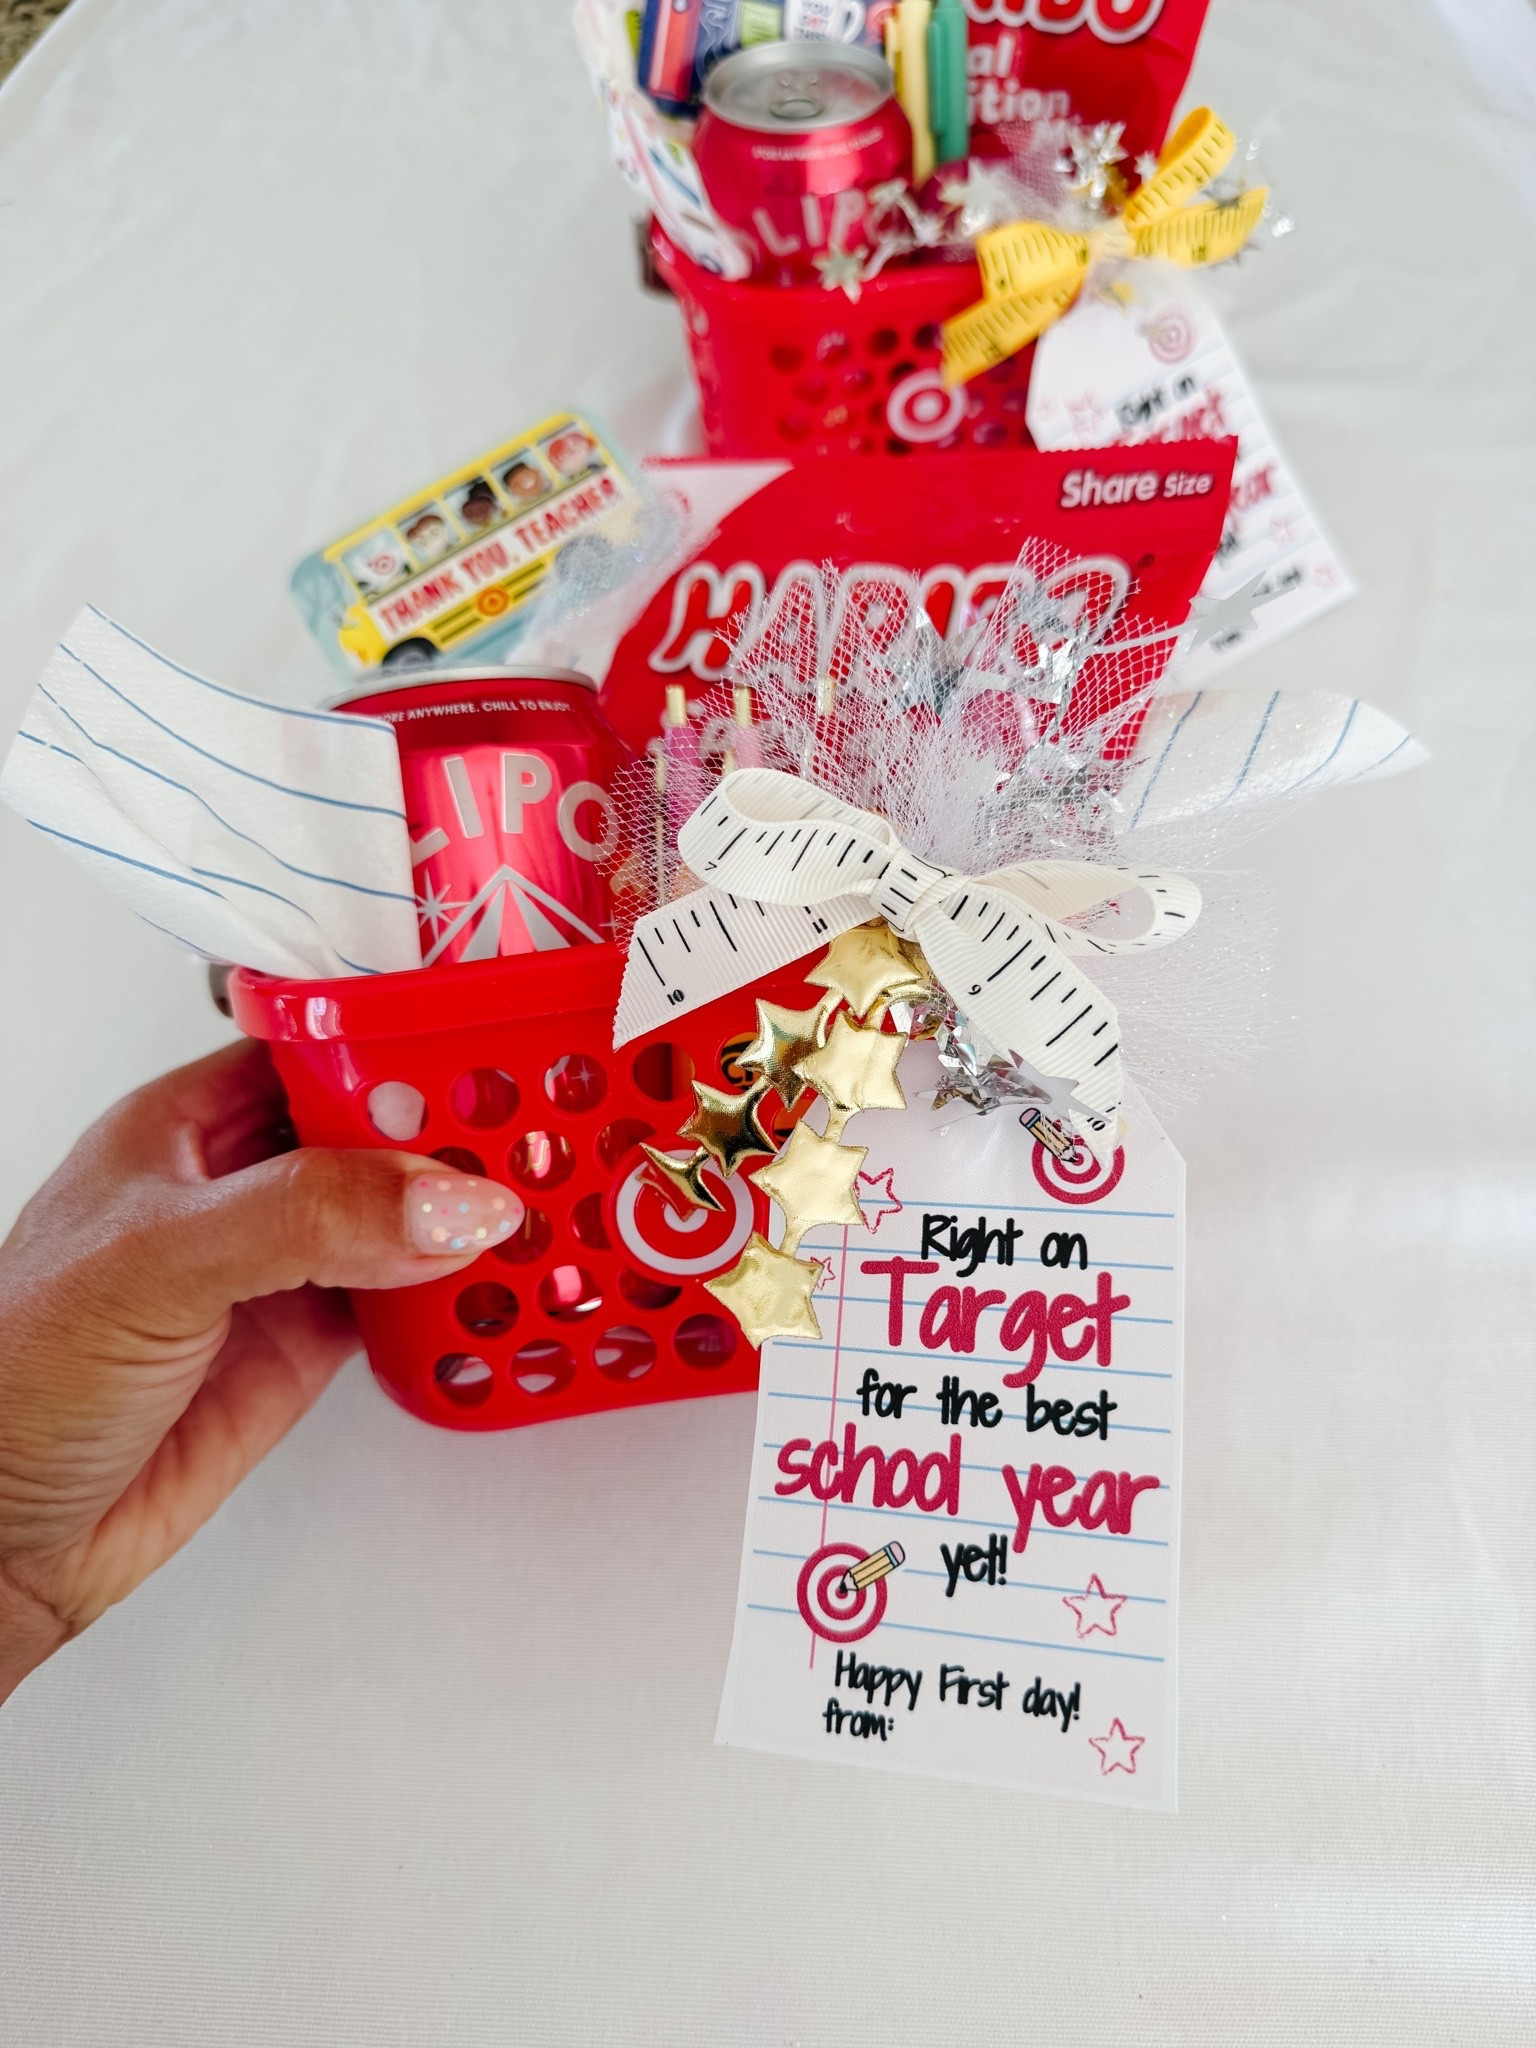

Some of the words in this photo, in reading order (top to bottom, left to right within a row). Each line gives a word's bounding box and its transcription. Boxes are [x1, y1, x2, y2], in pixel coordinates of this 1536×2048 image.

[1060, 468, 1159, 509] Share
[1163, 470, 1214, 499] Size
[381, 569, 464, 635] THANK
[406, 702, 480, 721] ANYWHERE.
[482, 697, 519, 712] CHILL
[520, 699, 538, 711] TO
[667, 990, 684, 1005] 10
[920, 1214, 1023, 1277] Right
[1041, 1233, 1087, 1270] on
[861, 1256, 1130, 1388] Target
[857, 1369, 917, 1418] for
[936, 1376, 1002, 1427] the
[1027, 1382, 1117, 1440] best
[775, 1423, 961, 1515] school
[1002, 1465, 1159, 1553] year
[941, 1535, 1007, 1597] yet!
[823, 1695, 893, 1741] from:
[832, 1652, 922, 1715] Happy
[940, 1666, 1009, 1710] First
[1023, 1679, 1080, 1732] day!
